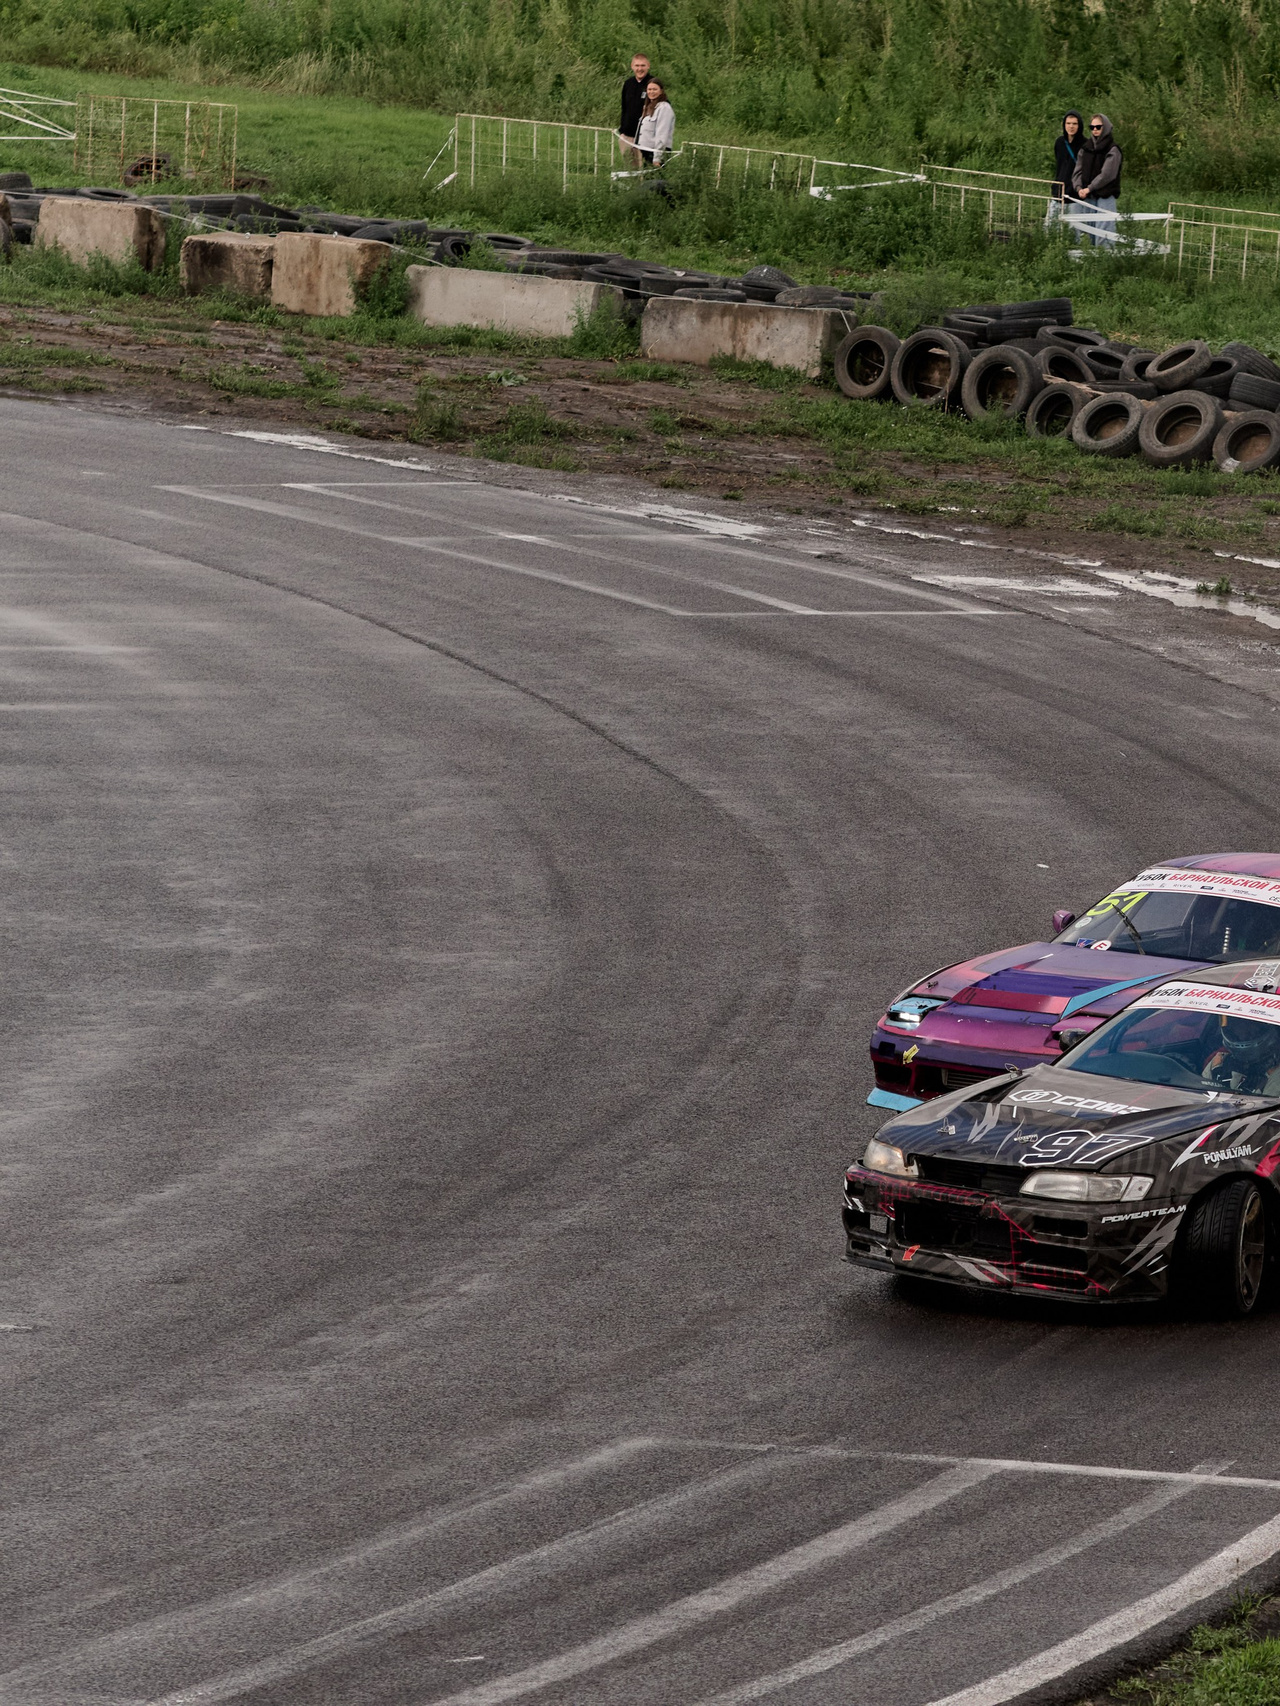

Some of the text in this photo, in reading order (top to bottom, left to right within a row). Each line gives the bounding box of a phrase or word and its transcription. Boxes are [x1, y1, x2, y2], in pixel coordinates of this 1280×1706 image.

[1168, 873, 1271, 890] БАРНАУЛЬСКОЙ
[1086, 891, 1149, 916] 51
[1018, 1130, 1155, 1167] 97
[1203, 1144, 1252, 1165] PONULYAM
